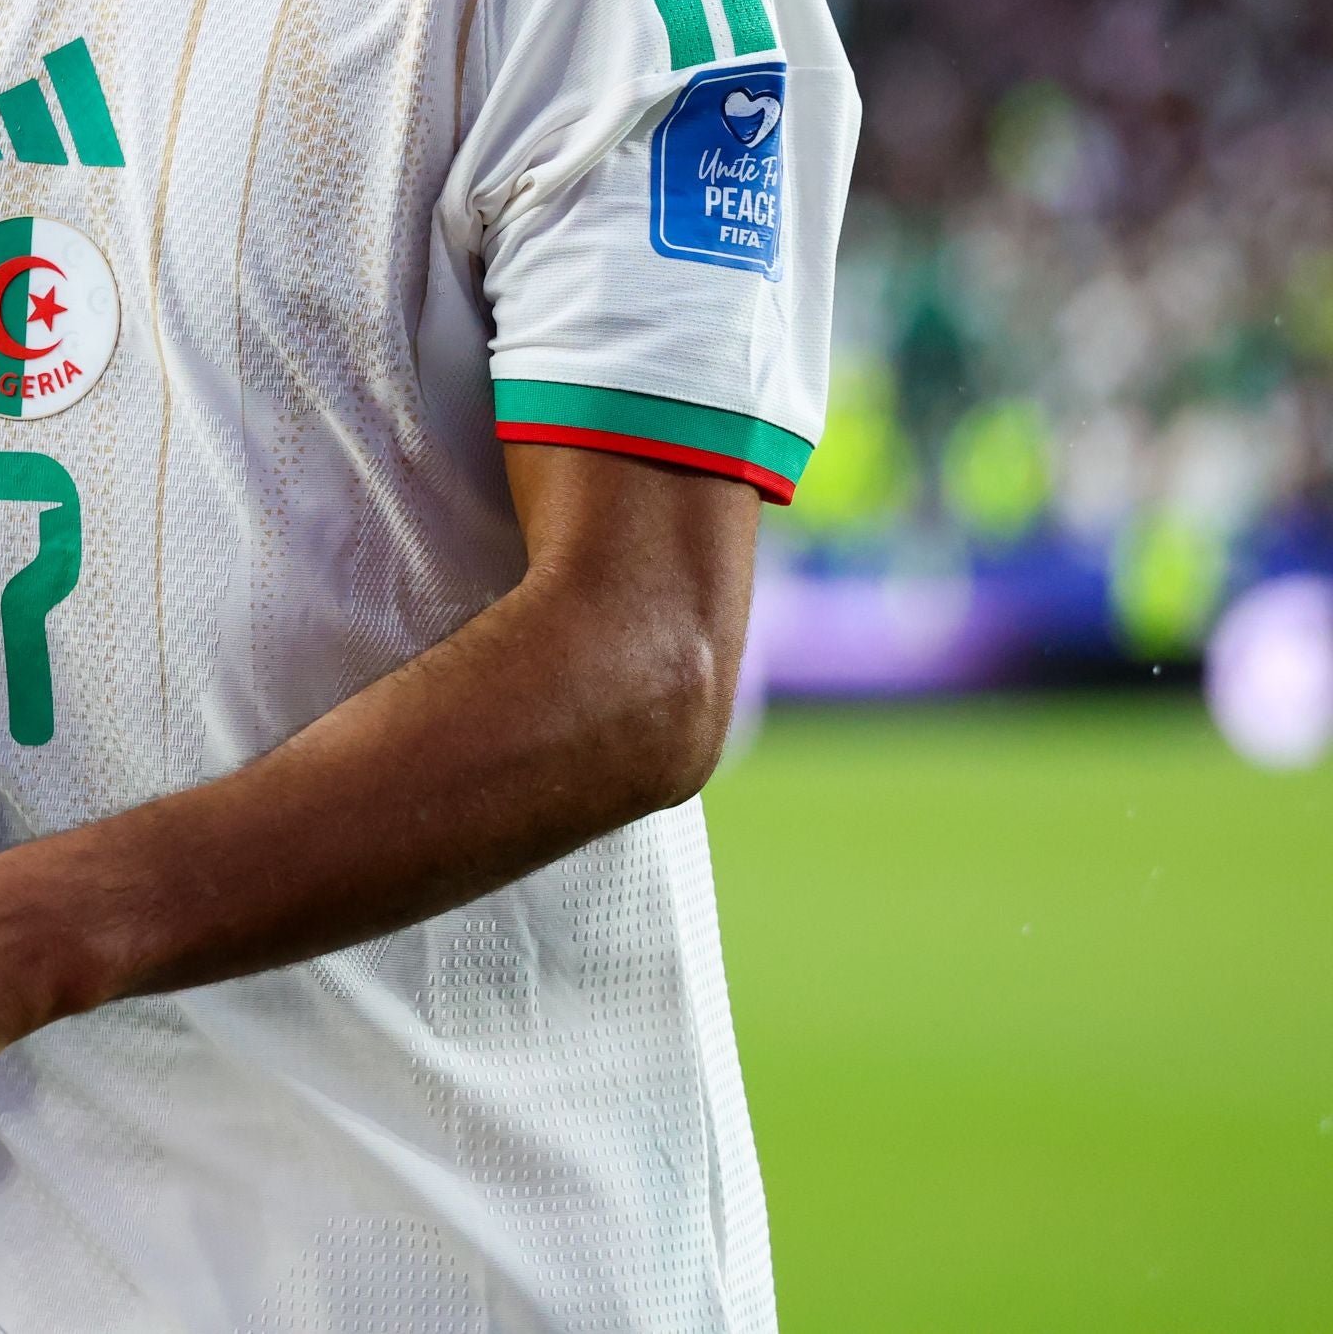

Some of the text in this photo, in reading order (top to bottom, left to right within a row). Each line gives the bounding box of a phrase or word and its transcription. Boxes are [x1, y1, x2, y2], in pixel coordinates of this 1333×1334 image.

[698, 147, 760, 185] Unite
[705, 185, 776, 229] PEACE
[719, 225, 761, 249] FIFA
